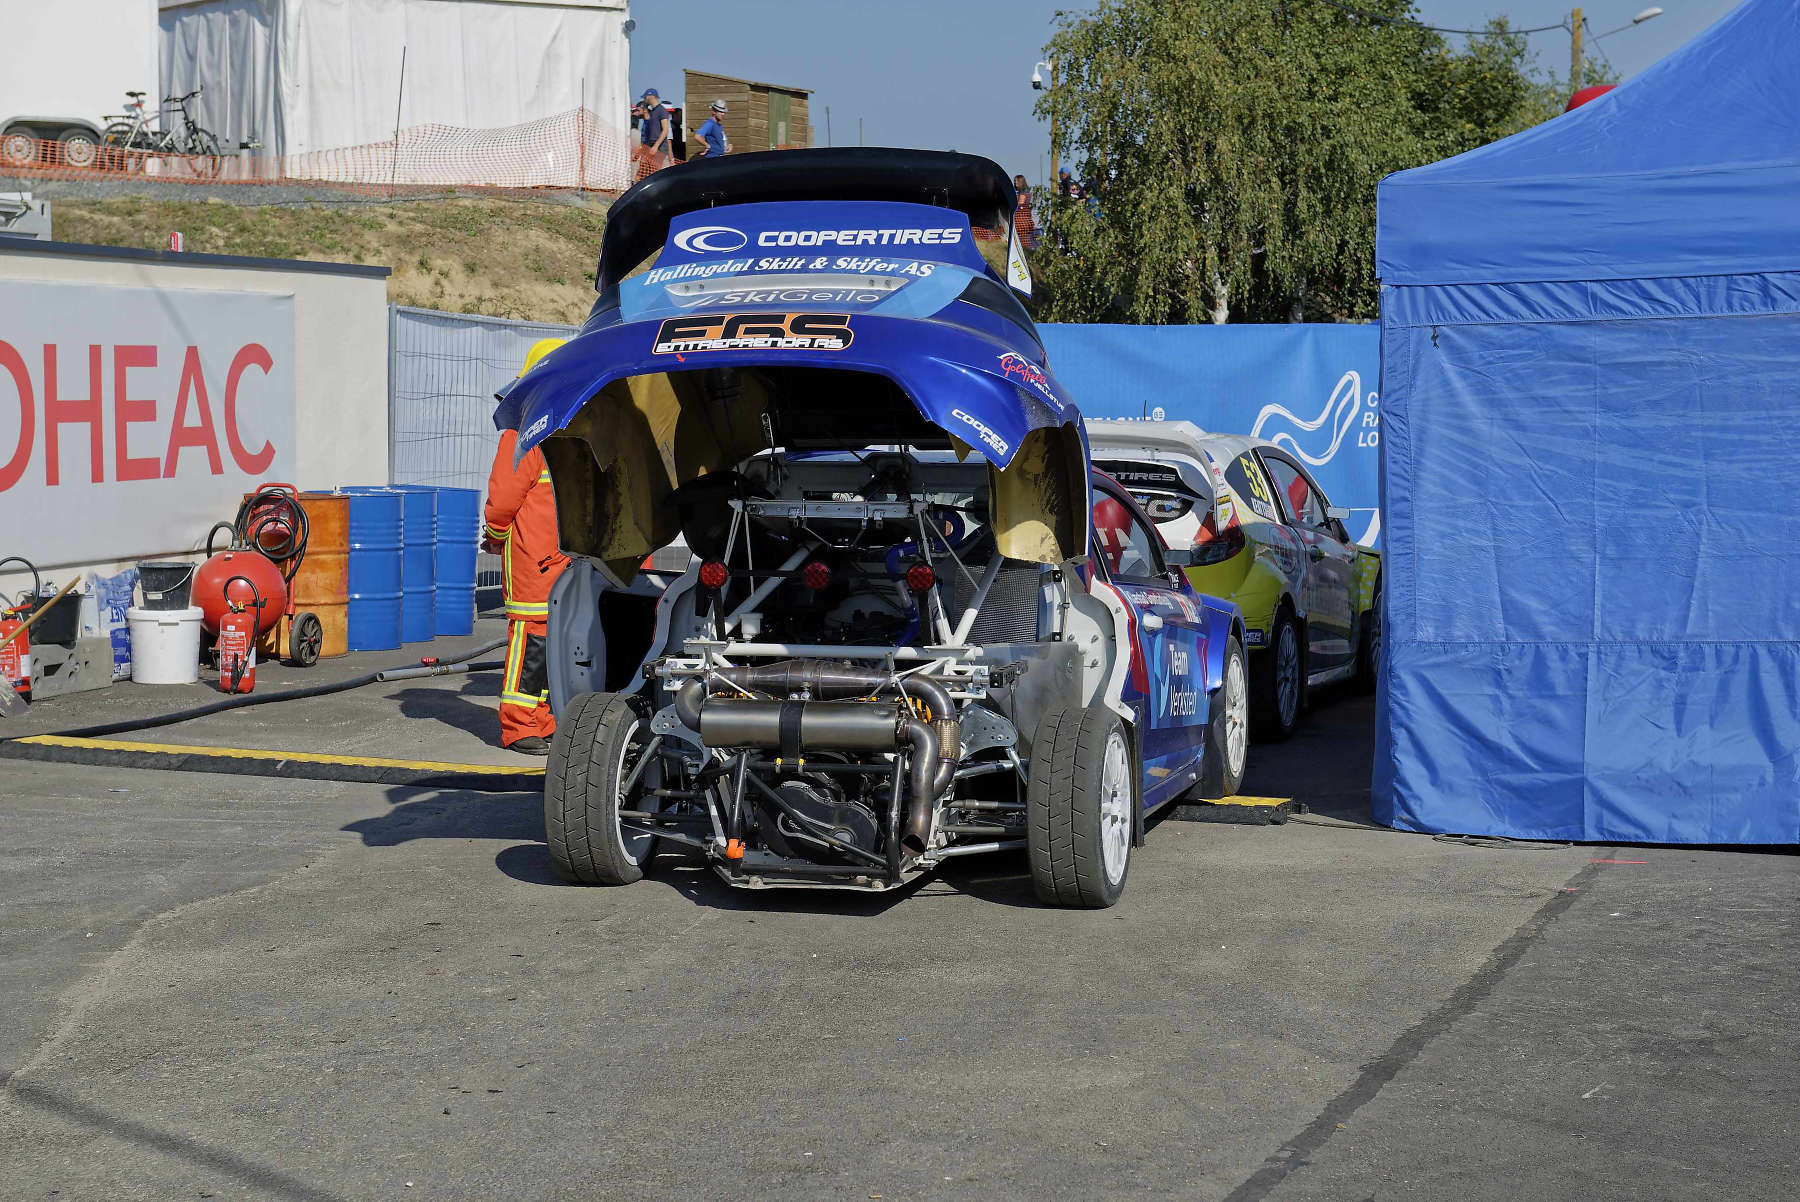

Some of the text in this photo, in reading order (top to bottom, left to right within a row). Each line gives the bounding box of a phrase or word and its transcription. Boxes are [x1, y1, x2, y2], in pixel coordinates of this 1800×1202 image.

[643, 256, 936, 286] Hallingdal Skilt & Skifer AS
[718, 289, 880, 305] SkiGeilo
[951, 408, 1009, 453] COOPER
[980, 431, 1004, 456] TIRES
[1240, 456, 1268, 502] 53
[1169, 644, 1189, 676] Team
